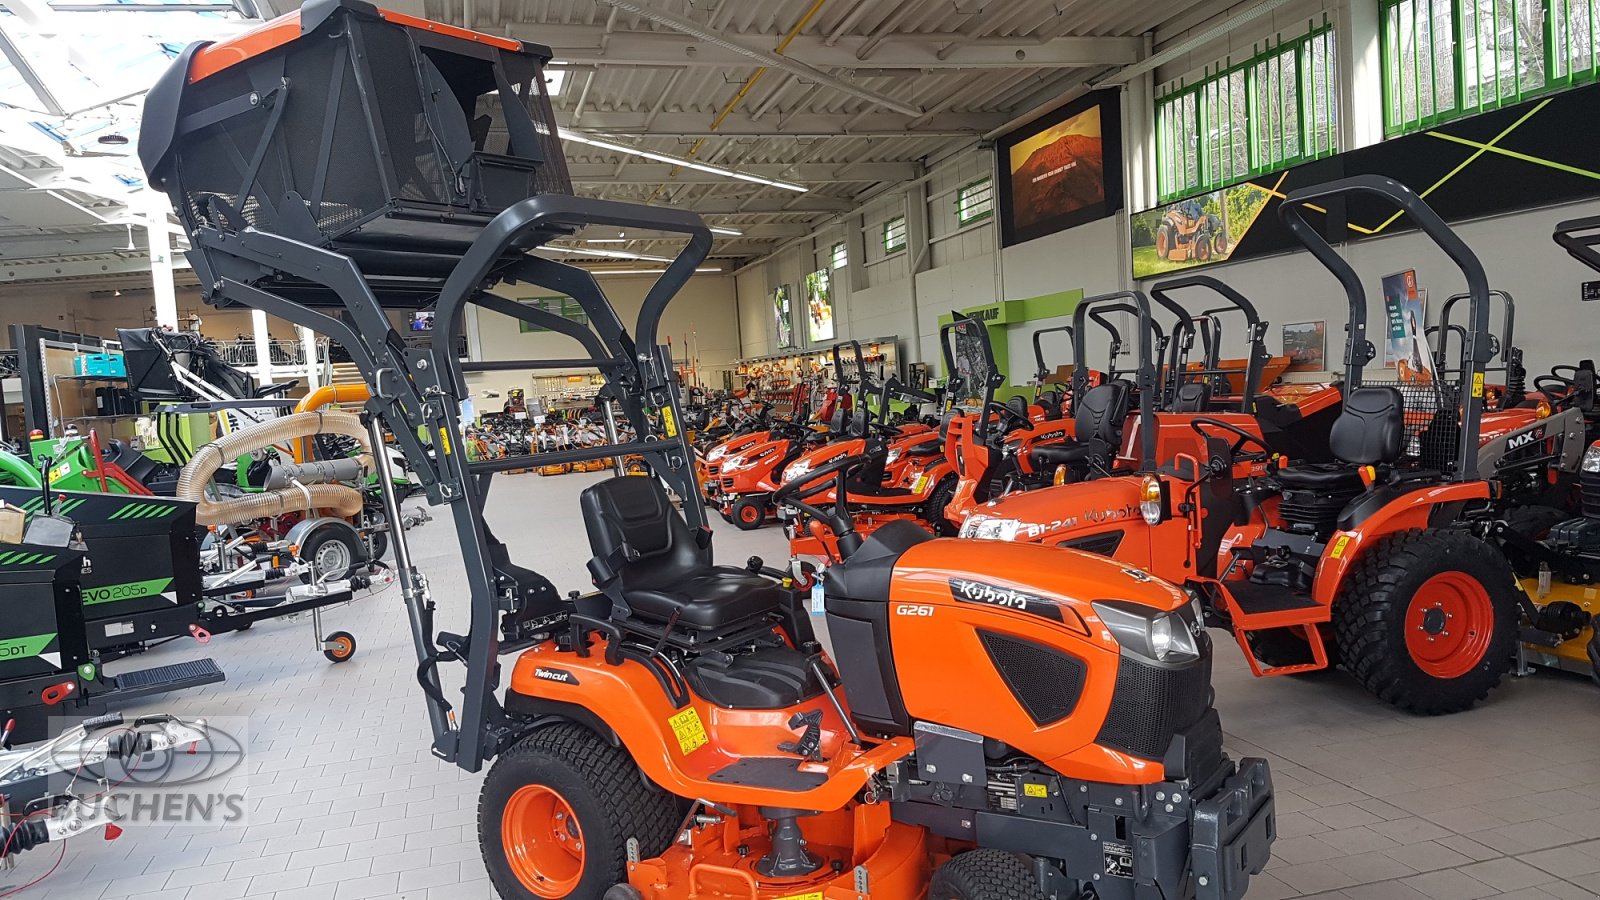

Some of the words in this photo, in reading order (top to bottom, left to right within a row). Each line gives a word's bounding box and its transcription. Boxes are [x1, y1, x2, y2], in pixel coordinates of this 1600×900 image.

[1508, 430, 1535, 449] MX
[1028, 516, 1078, 538] B1-241
[960, 581, 1027, 610] Kubota
[897, 605, 934, 616] G261
